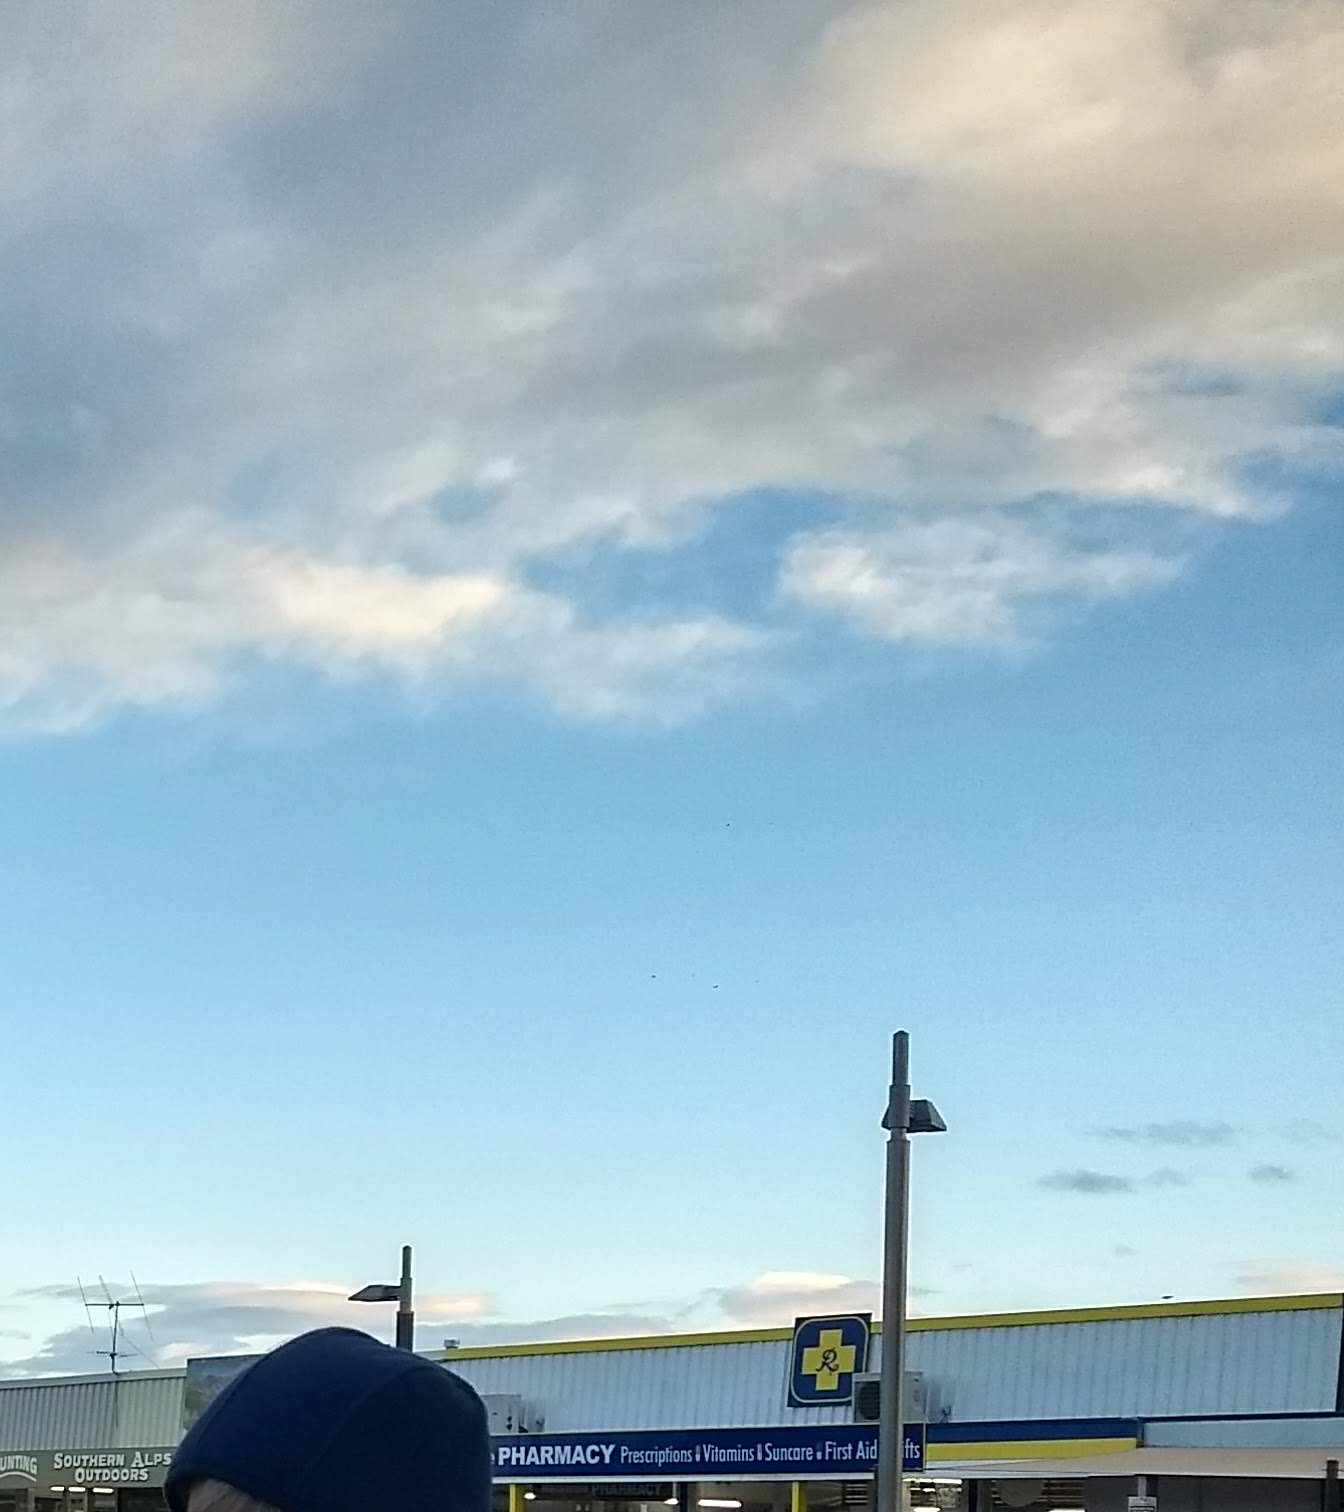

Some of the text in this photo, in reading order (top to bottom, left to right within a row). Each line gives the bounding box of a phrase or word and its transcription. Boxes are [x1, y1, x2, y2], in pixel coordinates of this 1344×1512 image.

[54, 1452, 125, 1470] SOUTHERN
[498, 1444, 616, 1466] PHARMACY
[620, 1446, 693, 1467] Prescriptions
[702, 1444, 754, 1462] Vitamins
[764, 1443, 813, 1461] Suncare
[825, 1441, 853, 1460] First
[856, 1439, 877, 1460] Aid
[901, 1438, 920, 1459] ifts
[75, 1468, 149, 1484] OUTDOORS
